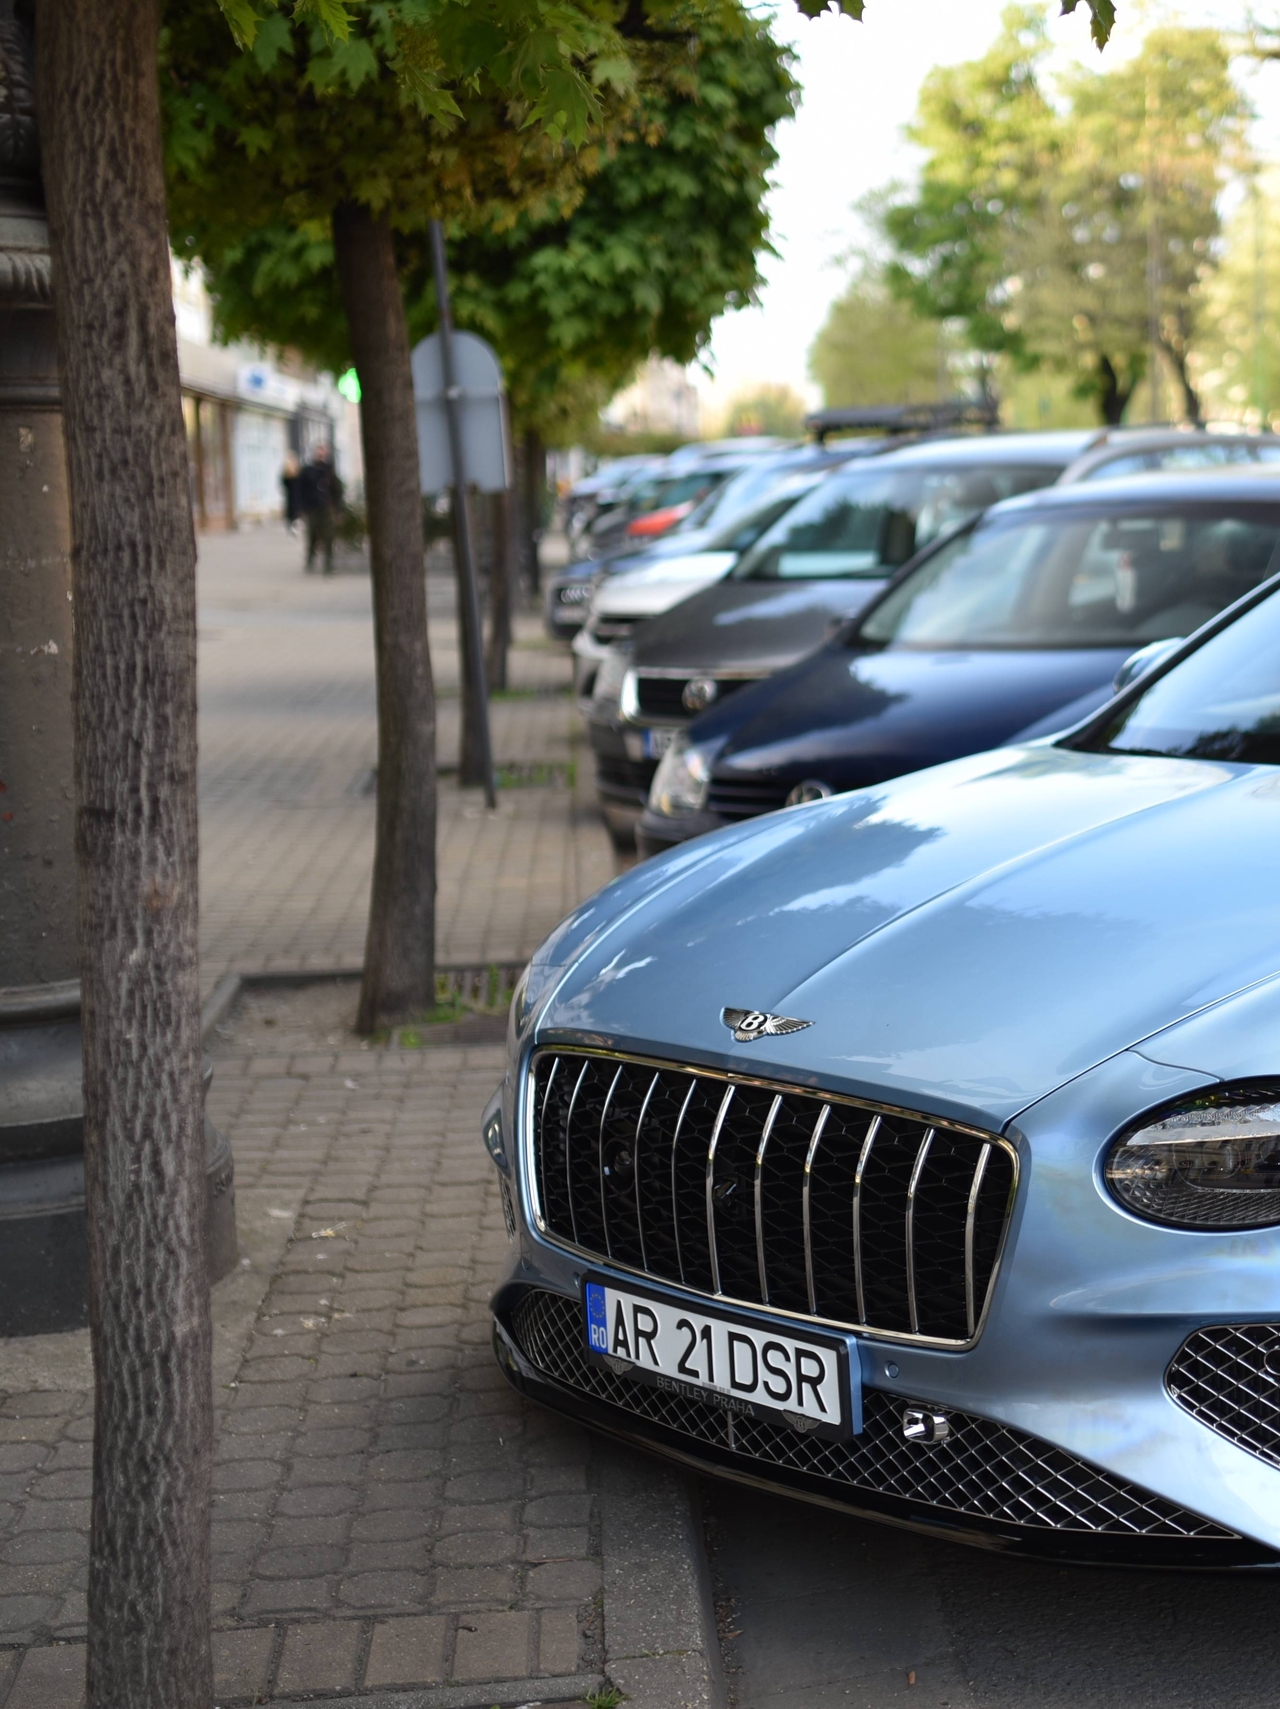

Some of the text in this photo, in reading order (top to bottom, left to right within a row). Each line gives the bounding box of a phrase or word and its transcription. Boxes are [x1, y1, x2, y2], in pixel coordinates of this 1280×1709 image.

[591, 1324, 607, 1349] RO
[612, 1299, 828, 1414] AR 21 DSR
[656, 1375, 709, 1402] BENTLEY
[713, 1393, 755, 1417] PRAHA
